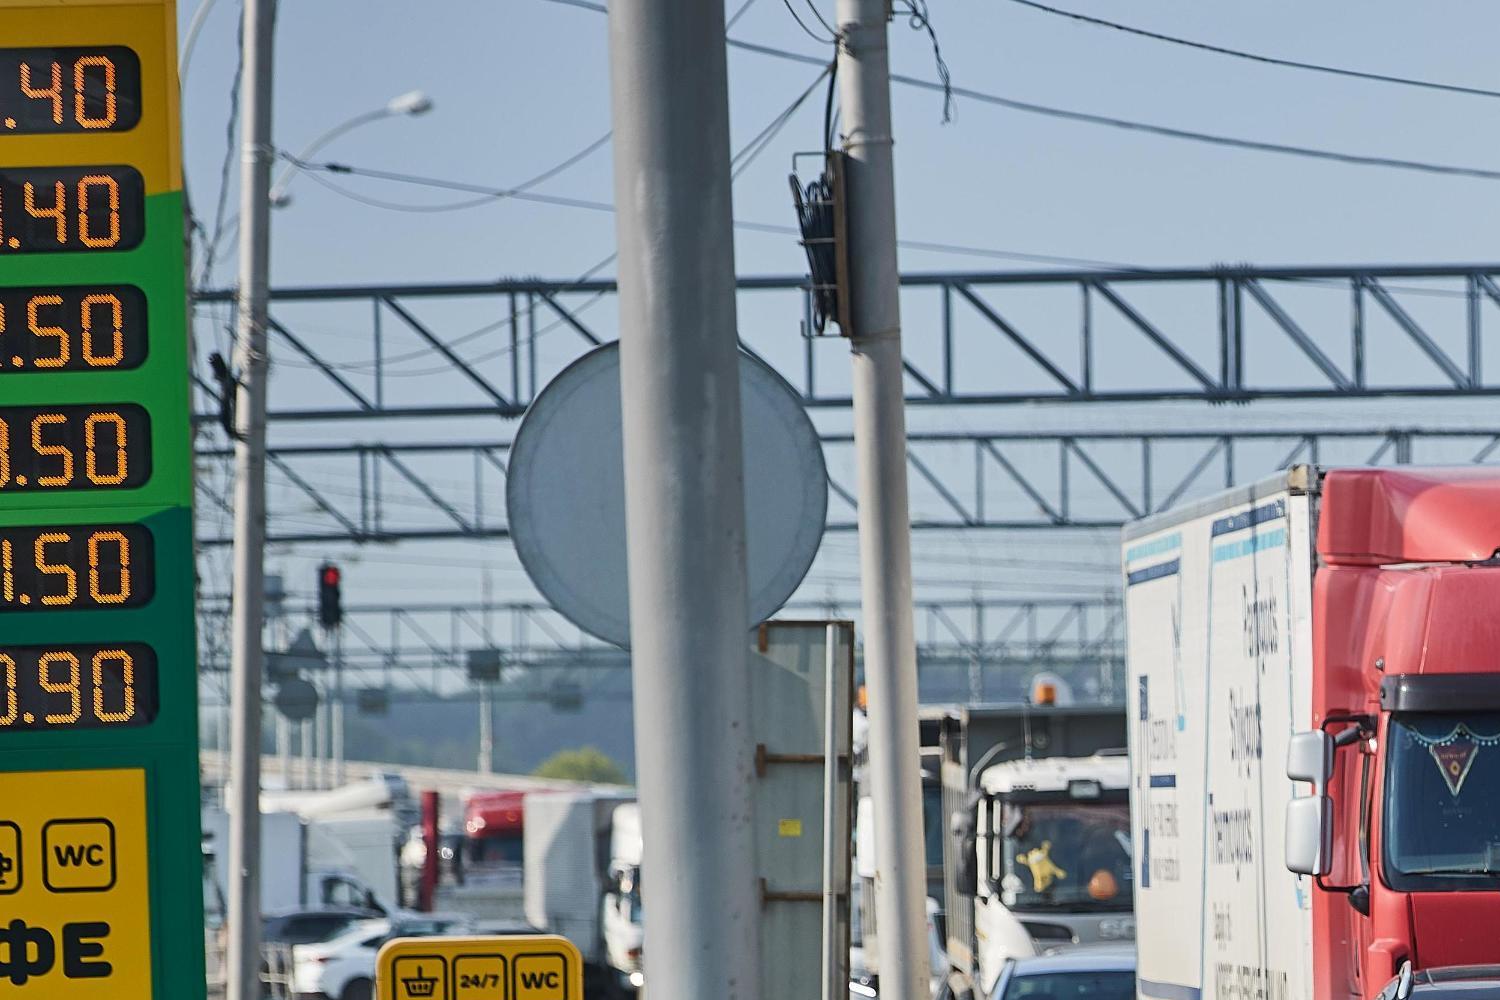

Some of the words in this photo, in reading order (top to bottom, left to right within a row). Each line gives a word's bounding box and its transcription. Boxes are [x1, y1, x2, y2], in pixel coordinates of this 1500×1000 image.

[0, 174, 120, 248] .40
[0, 294, 123, 367] .50
[0, 412, 129, 487] .50
[54, 844, 104, 867] WC
[460, 973, 499, 989] 24/7
[521, 972, 559, 989] WC
